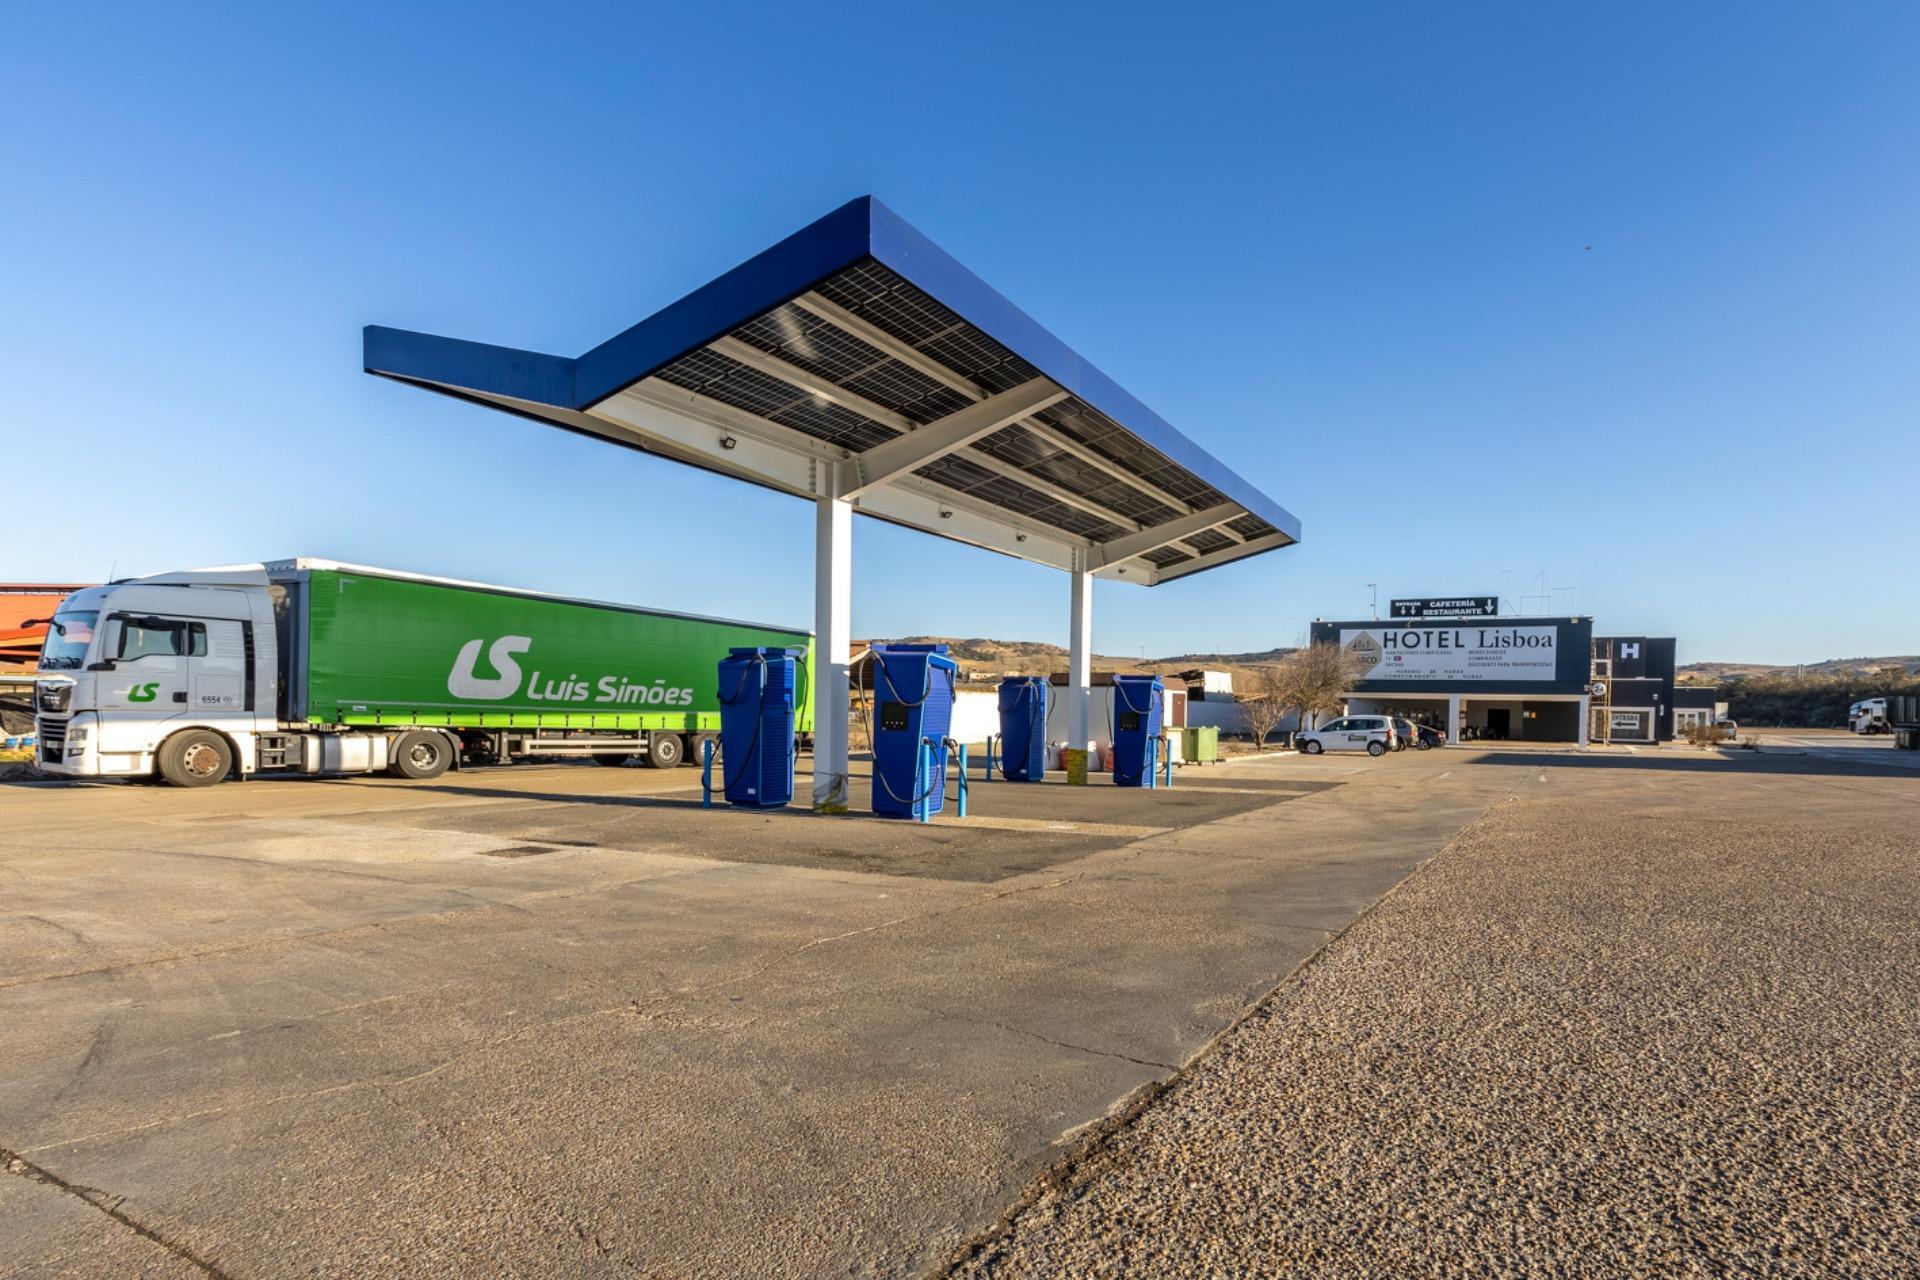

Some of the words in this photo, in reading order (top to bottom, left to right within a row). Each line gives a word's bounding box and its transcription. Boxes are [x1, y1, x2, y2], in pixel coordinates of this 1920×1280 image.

[1423, 608, 1482, 616] RESTAURANTE
[1430, 600, 1475, 608] CAFETERÍA
[1384, 631, 1465, 649] HOTEL
[1478, 629, 1553, 648] Lisboa
[1621, 643, 1640, 659] H
[447, 634, 533, 700] LS
[128, 682, 160, 702] LS
[527, 671, 589, 701] Luis
[595, 675, 693, 706] Simões
